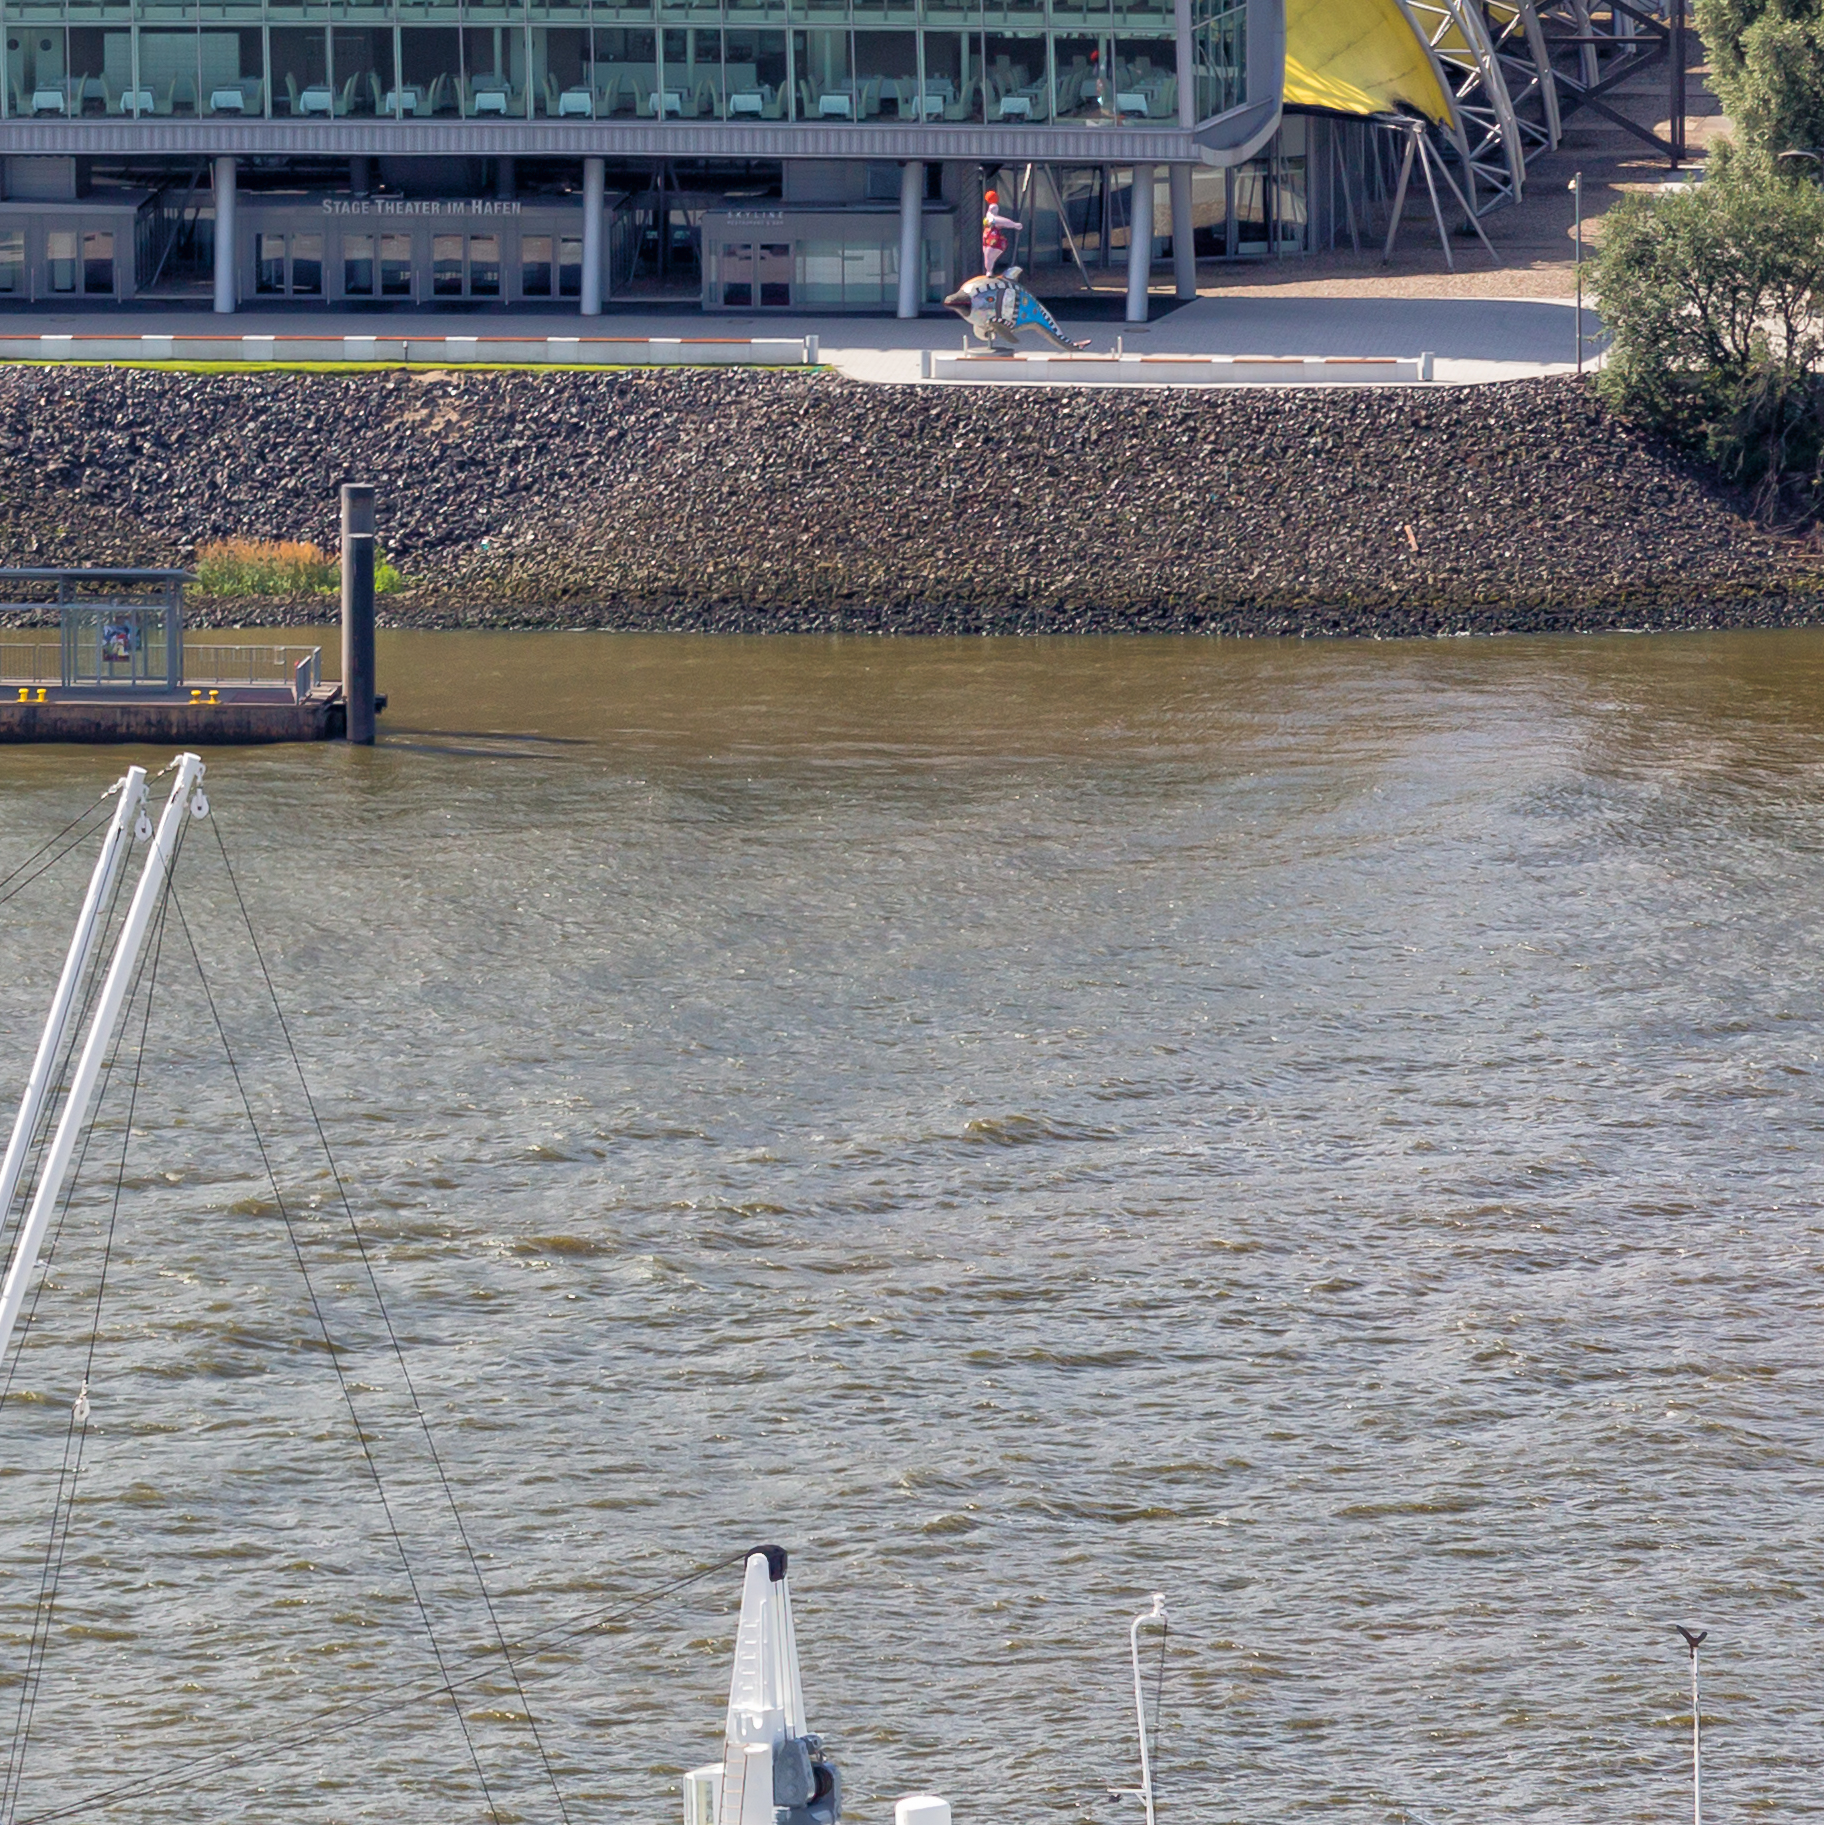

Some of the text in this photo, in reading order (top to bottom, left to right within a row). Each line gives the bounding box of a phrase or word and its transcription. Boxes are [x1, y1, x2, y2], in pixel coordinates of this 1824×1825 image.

[322, 199, 370, 214] STAGE
[375, 199, 441, 215] THEATER
[471, 199, 522, 215] HAFEN
